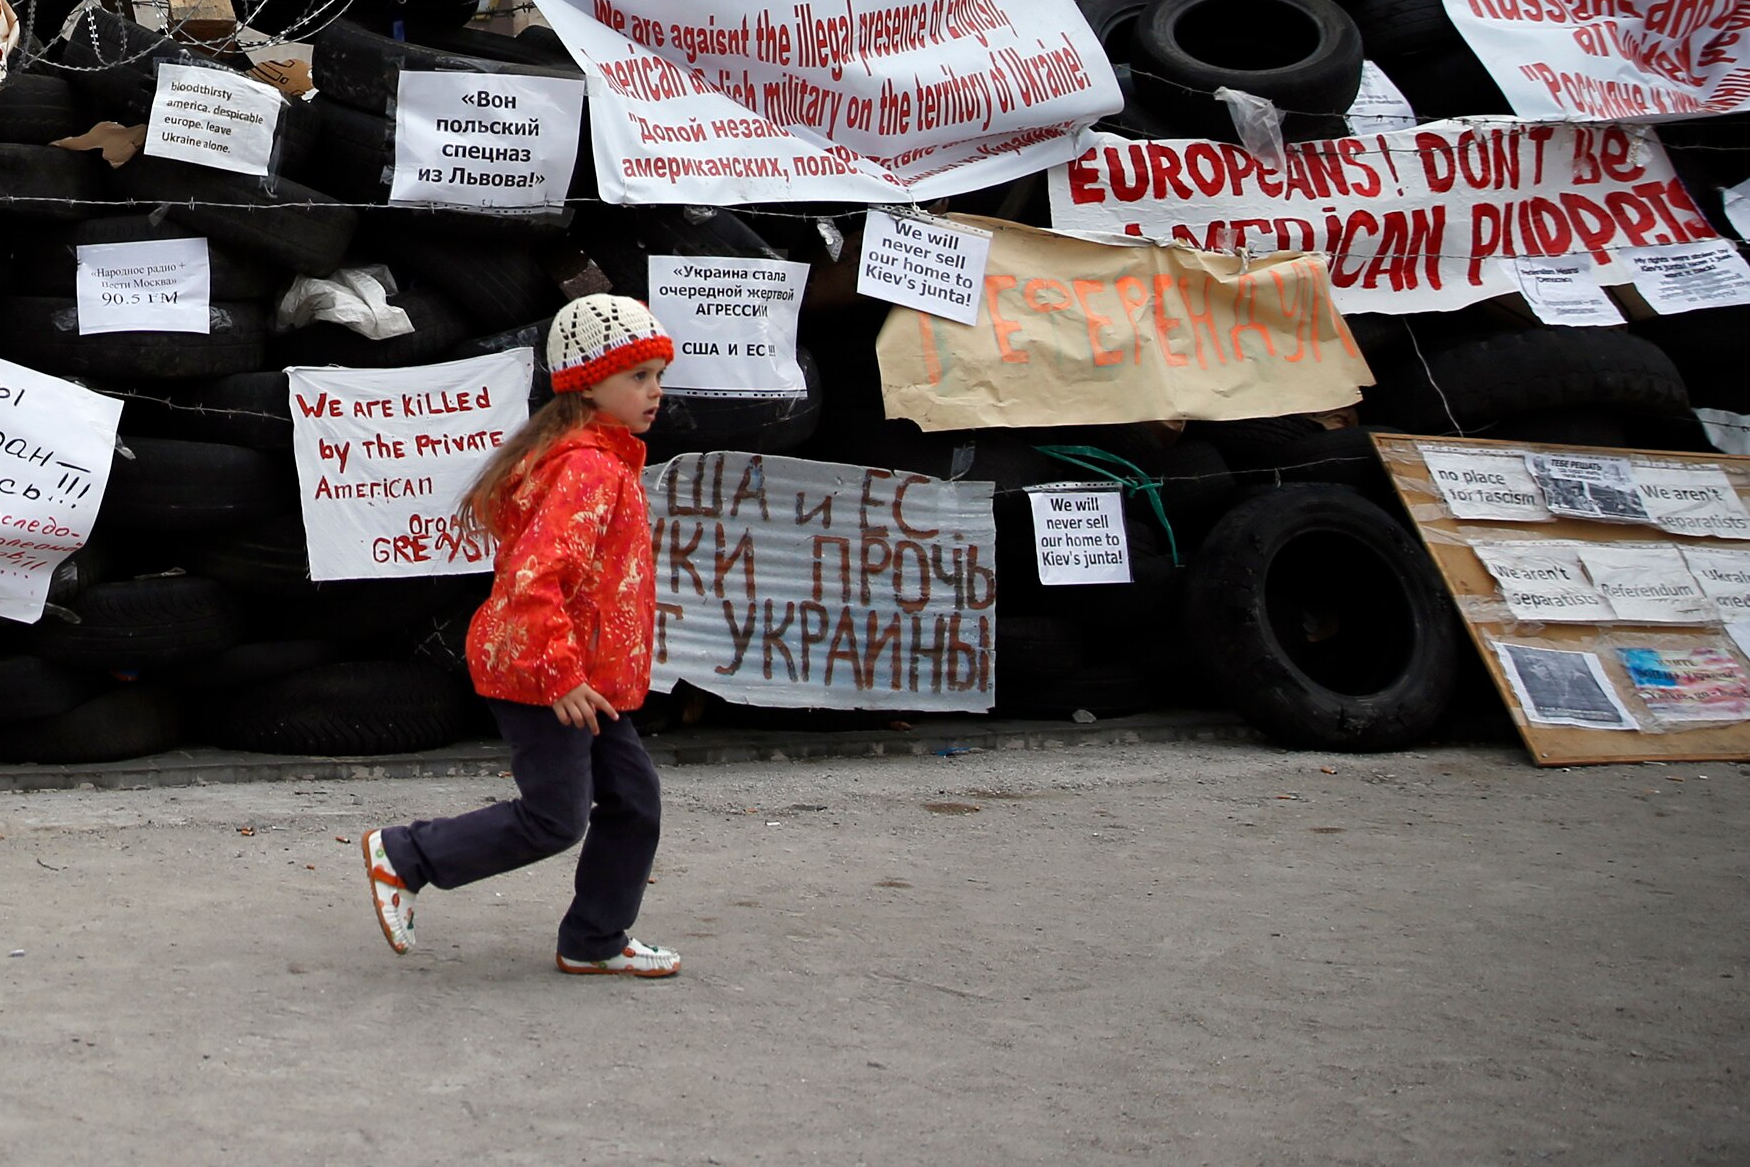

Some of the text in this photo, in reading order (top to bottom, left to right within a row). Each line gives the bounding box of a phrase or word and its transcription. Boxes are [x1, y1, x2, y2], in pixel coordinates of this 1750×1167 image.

[631, 14, 665, 49] are
[756, 9, 791, 66] the
[859, 2, 927, 77] presence
[171, 82, 233, 101] bloodthirsty
[763, 72, 843, 141] military
[846, 95, 873, 132] on
[878, 78, 912, 136] the
[915, 65, 993, 132] territory
[1009, 32, 1092, 108] Ukraine!
[462, 91, 517, 109] «Вон
[213, 105, 264, 125] despicable
[206, 122, 232, 135] leave
[436, 118, 539, 136] польский
[161, 132, 230, 154] Ukraine alone.
[442, 143, 531, 163] спецназ
[418, 167, 545, 188] из Львова!»
[622, 155, 790, 184] американских,
[895, 221, 959, 250] We will
[882, 238, 966, 269] never sell
[147, 264, 176, 276] радио
[673, 266, 786, 282] «Украина стала
[868, 251, 973, 289] our home to
[133, 278, 177, 288] Москва»
[866, 264, 972, 307] Kiev's junta!
[102, 292, 140, 306] 90.5
[659, 285, 794, 301] очередной жертвой
[696, 303, 768, 317] АГРЕССИИ
[682, 342, 738, 356] США И
[296, 393, 344, 419] WE
[319, 438, 350, 474] by
[1438, 469, 1506, 485] no place
[667, 452, 770, 522] ША
[860, 468, 940, 540] ЕС
[1448, 489, 1536, 506] for fascism
[1640, 484, 1723, 501] We aren't
[1051, 497, 1099, 511] We will
[1047, 514, 1108, 529] never sell
[1657, 515, 1747, 530] separatists
[1041, 533, 1119, 547] our home to
[1042, 550, 1122, 568] Kiev's junta!
[805, 534, 995, 613] ПРОЧЬ
[1494, 563, 1570, 581] We aren't
[1602, 583, 1693, 598] Referendum
[1513, 592, 1599, 608] separatists
[714, 597, 991, 694] УКРАИНЫ
